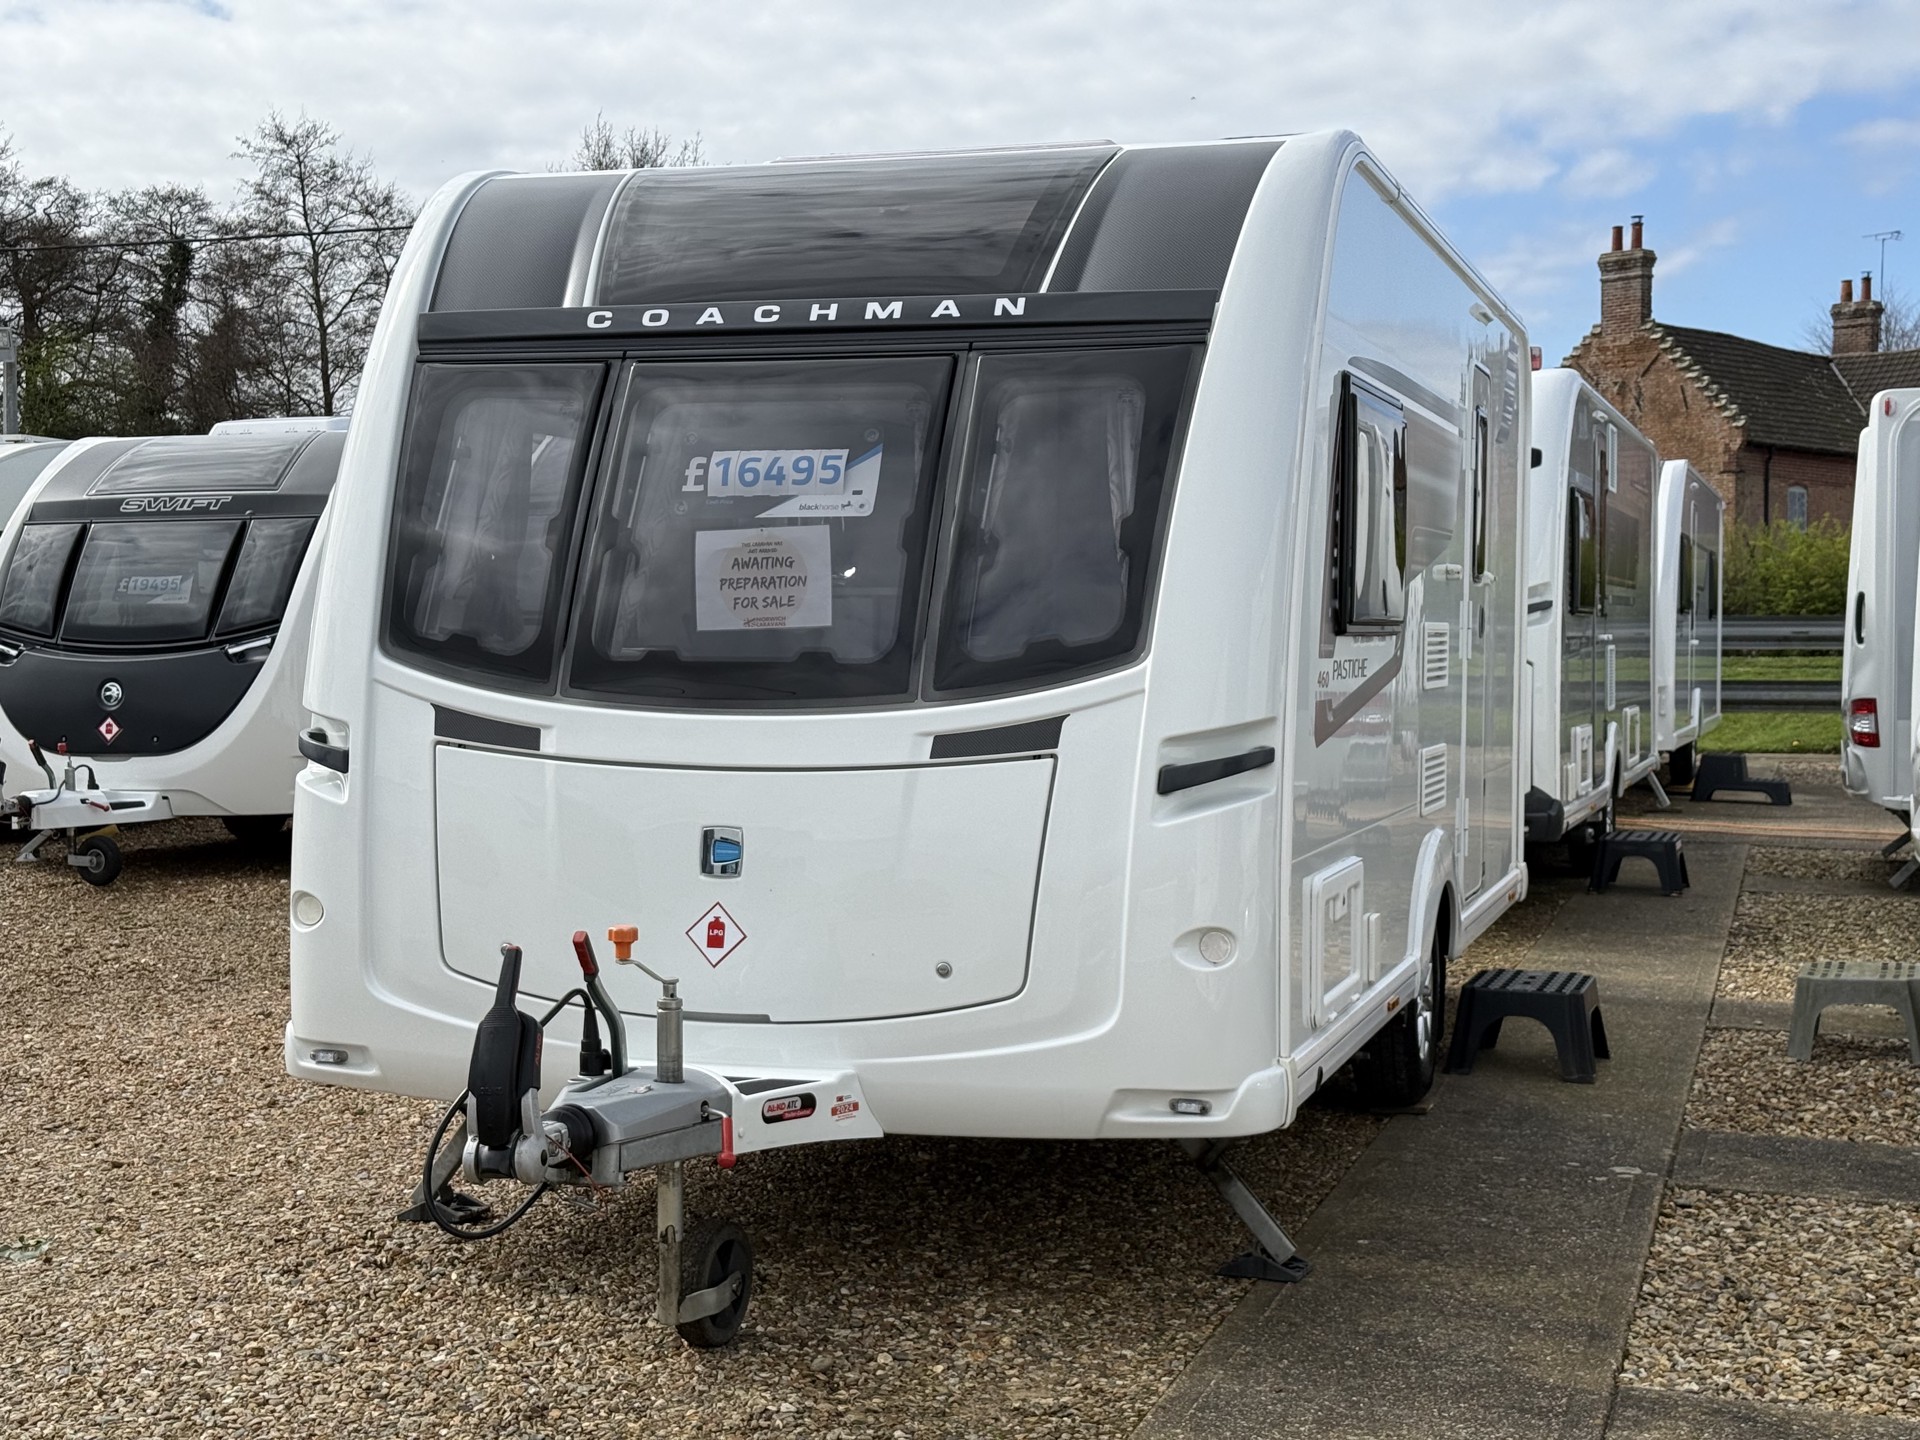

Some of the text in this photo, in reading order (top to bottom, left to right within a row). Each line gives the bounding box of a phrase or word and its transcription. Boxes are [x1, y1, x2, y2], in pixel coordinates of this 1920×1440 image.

[586, 297, 1027, 329] COACHMAN
[681, 455, 843, 492] £16495
[120, 496, 232, 512] SWIFT
[731, 556, 796, 571] AWAITING
[719, 575, 808, 591] PREPARATION
[733, 595, 796, 611] FOR SALE
[1333, 658, 1368, 680] PASTICHE
[1317, 670, 1330, 688] 460
[786, 1099, 799, 1110] ATC
[836, 1103, 854, 1114] 2024
